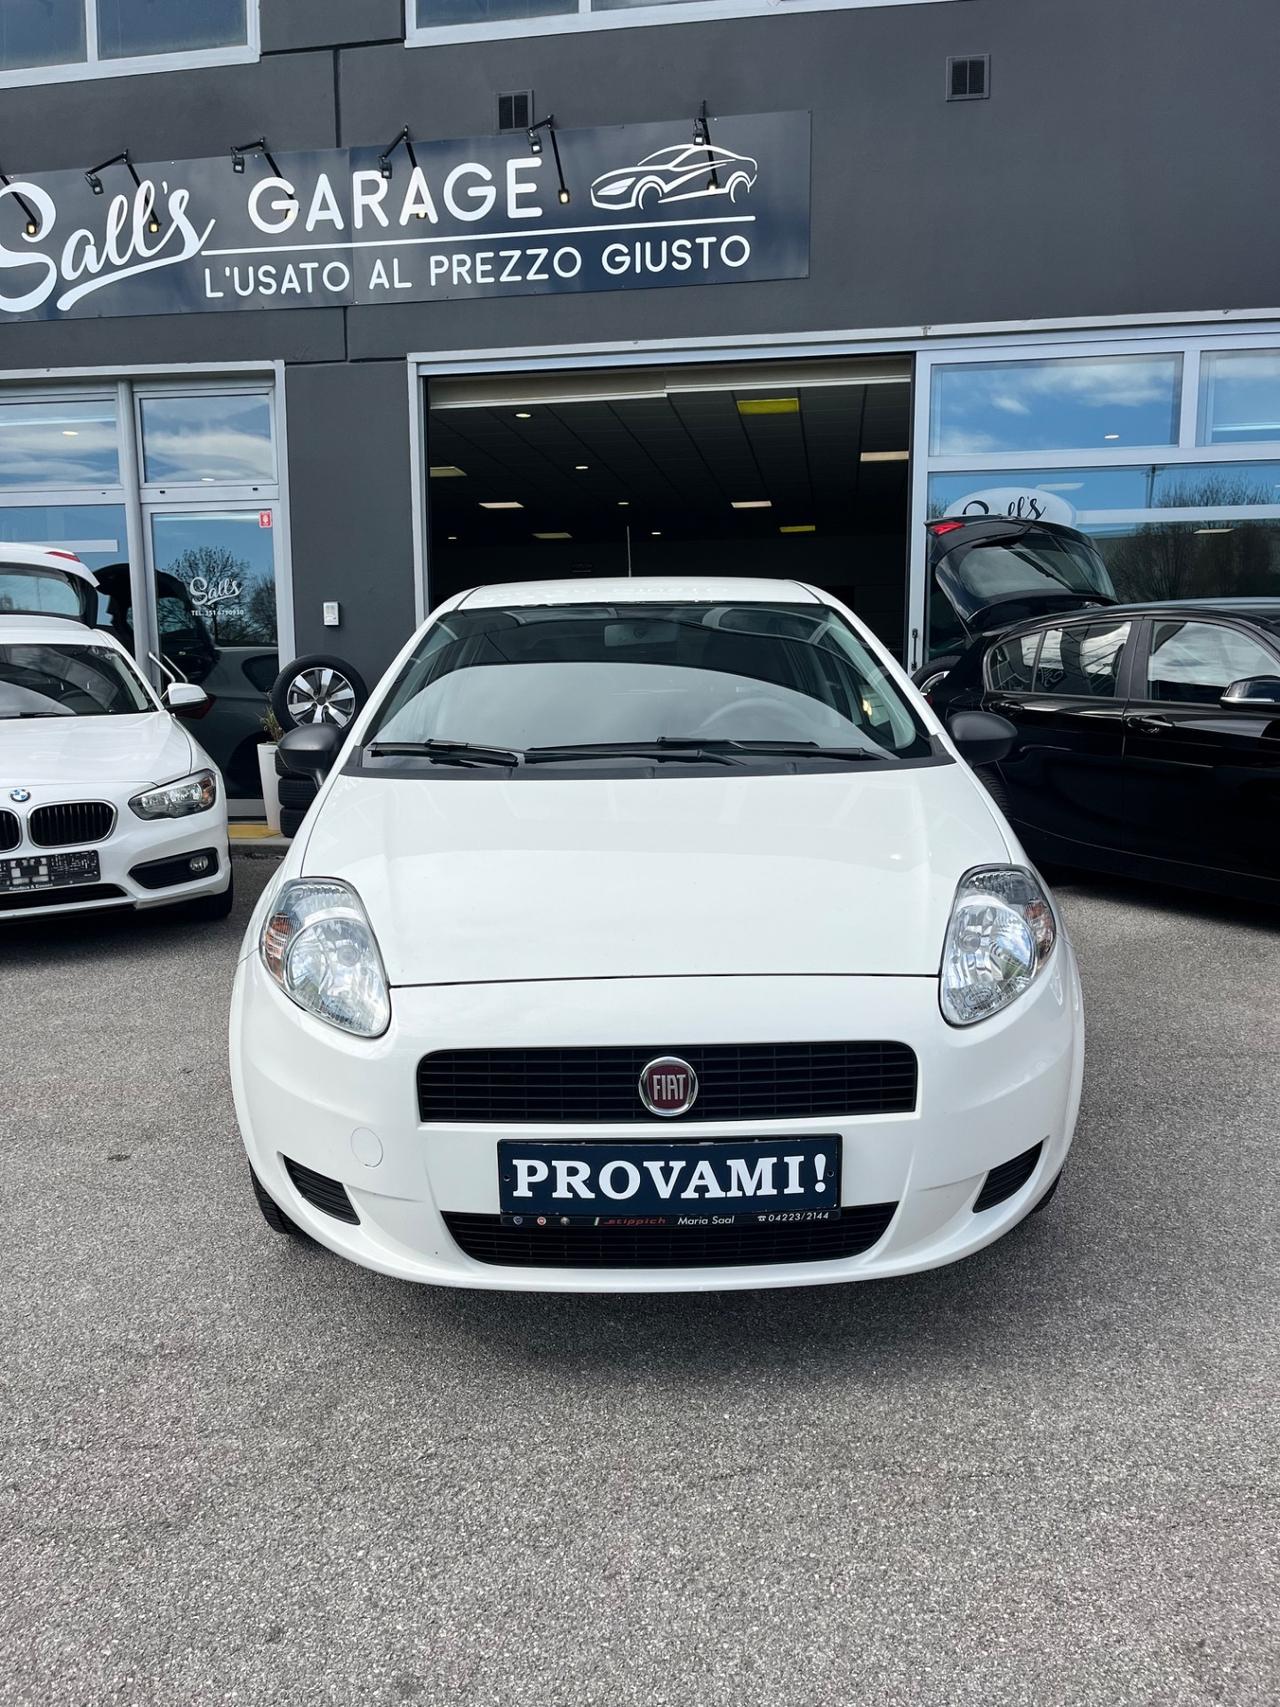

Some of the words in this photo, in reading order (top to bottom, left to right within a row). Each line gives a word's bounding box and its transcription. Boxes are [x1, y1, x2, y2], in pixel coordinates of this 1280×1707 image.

[0, 179, 217, 313] Sall's
[247, 156, 544, 235] GARAGE
[204, 261, 351, 298] L'USATO
[368, 257, 413, 291] AL
[429, 246, 582, 287] PREZZO
[601, 234, 751, 275] GIUSTO
[962, 496, 1047, 520] ll's
[189, 576, 242, 606] Sall's
[652, 1074, 686, 1101] FIAT
[512, 1153, 827, 1200] PROVAMI!
[677, 1216, 709, 1225] Maria
[711, 1215, 735, 1225] Saal
[768, 1212, 829, 1222] 04223/2144
